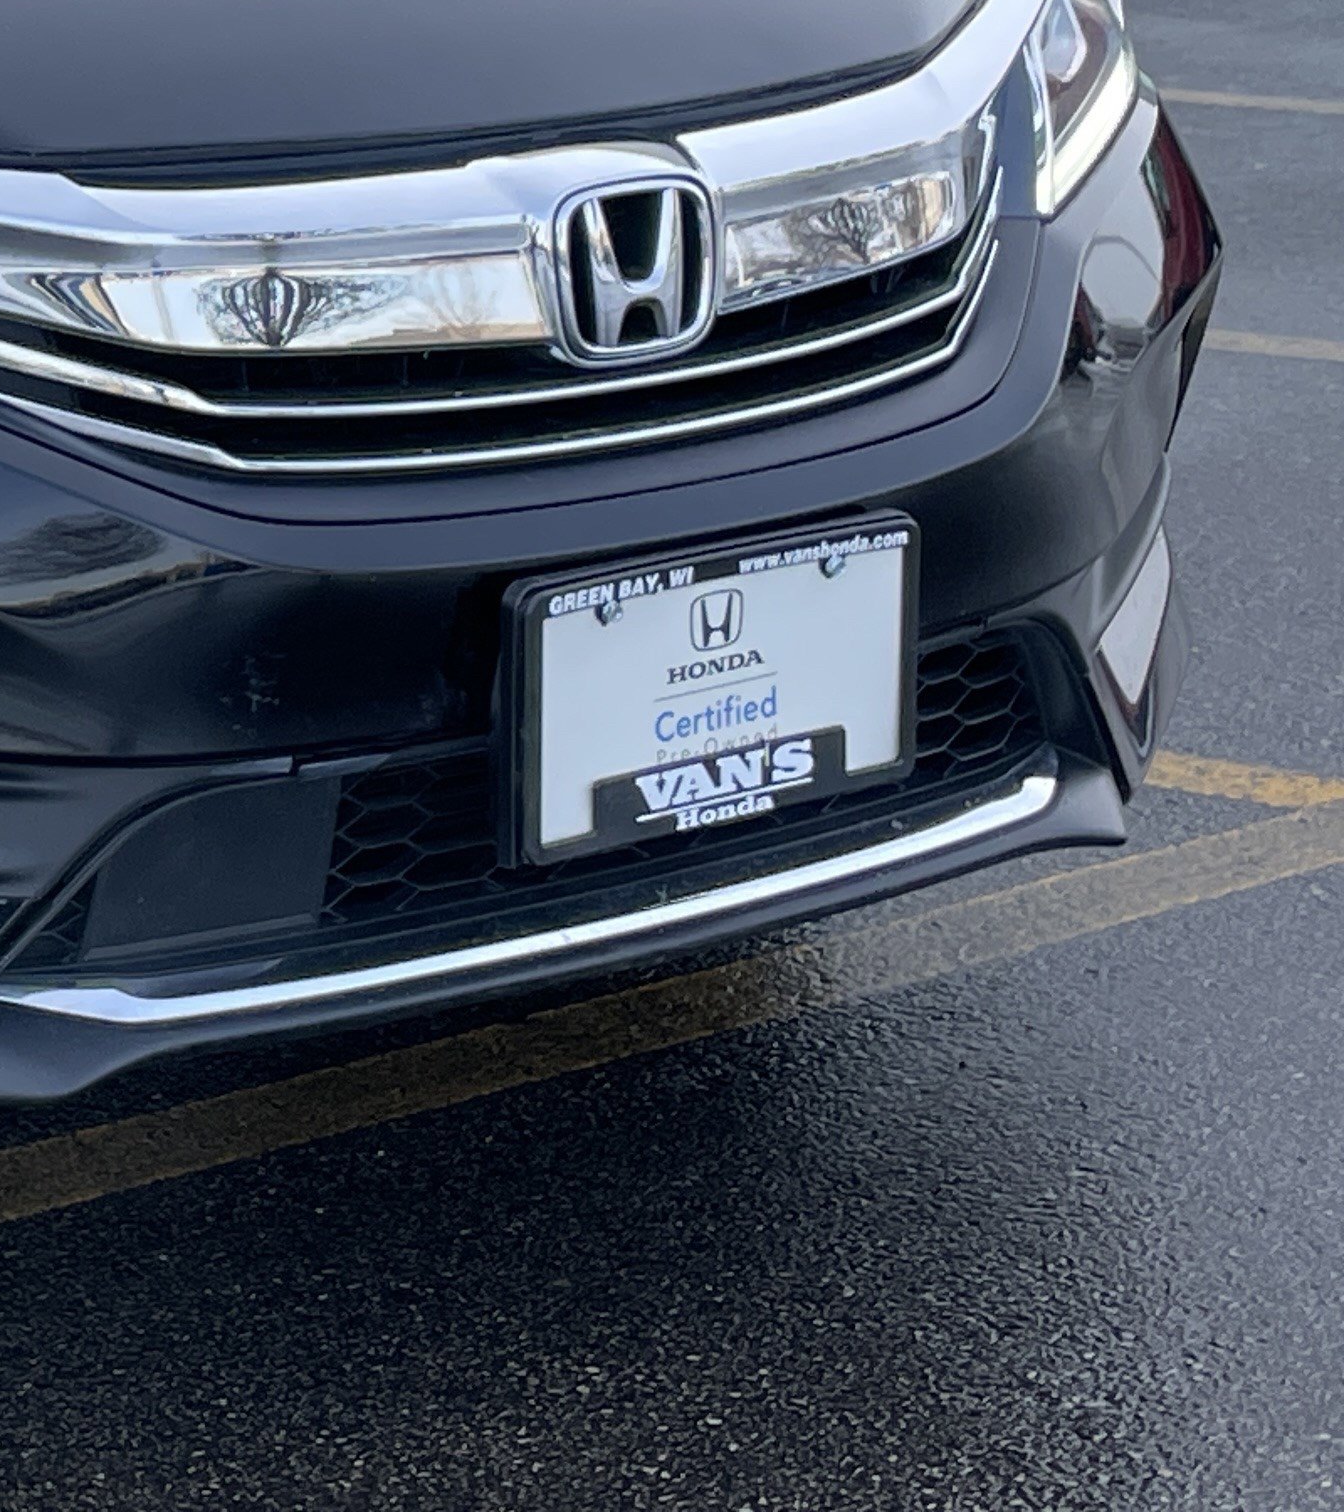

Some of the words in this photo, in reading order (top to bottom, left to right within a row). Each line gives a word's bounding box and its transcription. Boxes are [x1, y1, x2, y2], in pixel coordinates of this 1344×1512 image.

[548, 582, 615, 618] GREEN
[617, 571, 666, 602] BAY,
[668, 565, 696, 590] WI
[738, 530, 909, 575] www.vanshonda.com
[665, 648, 766, 685] HONDA
[654, 684, 779, 743] Certified
[674, 794, 776, 832] Honda
